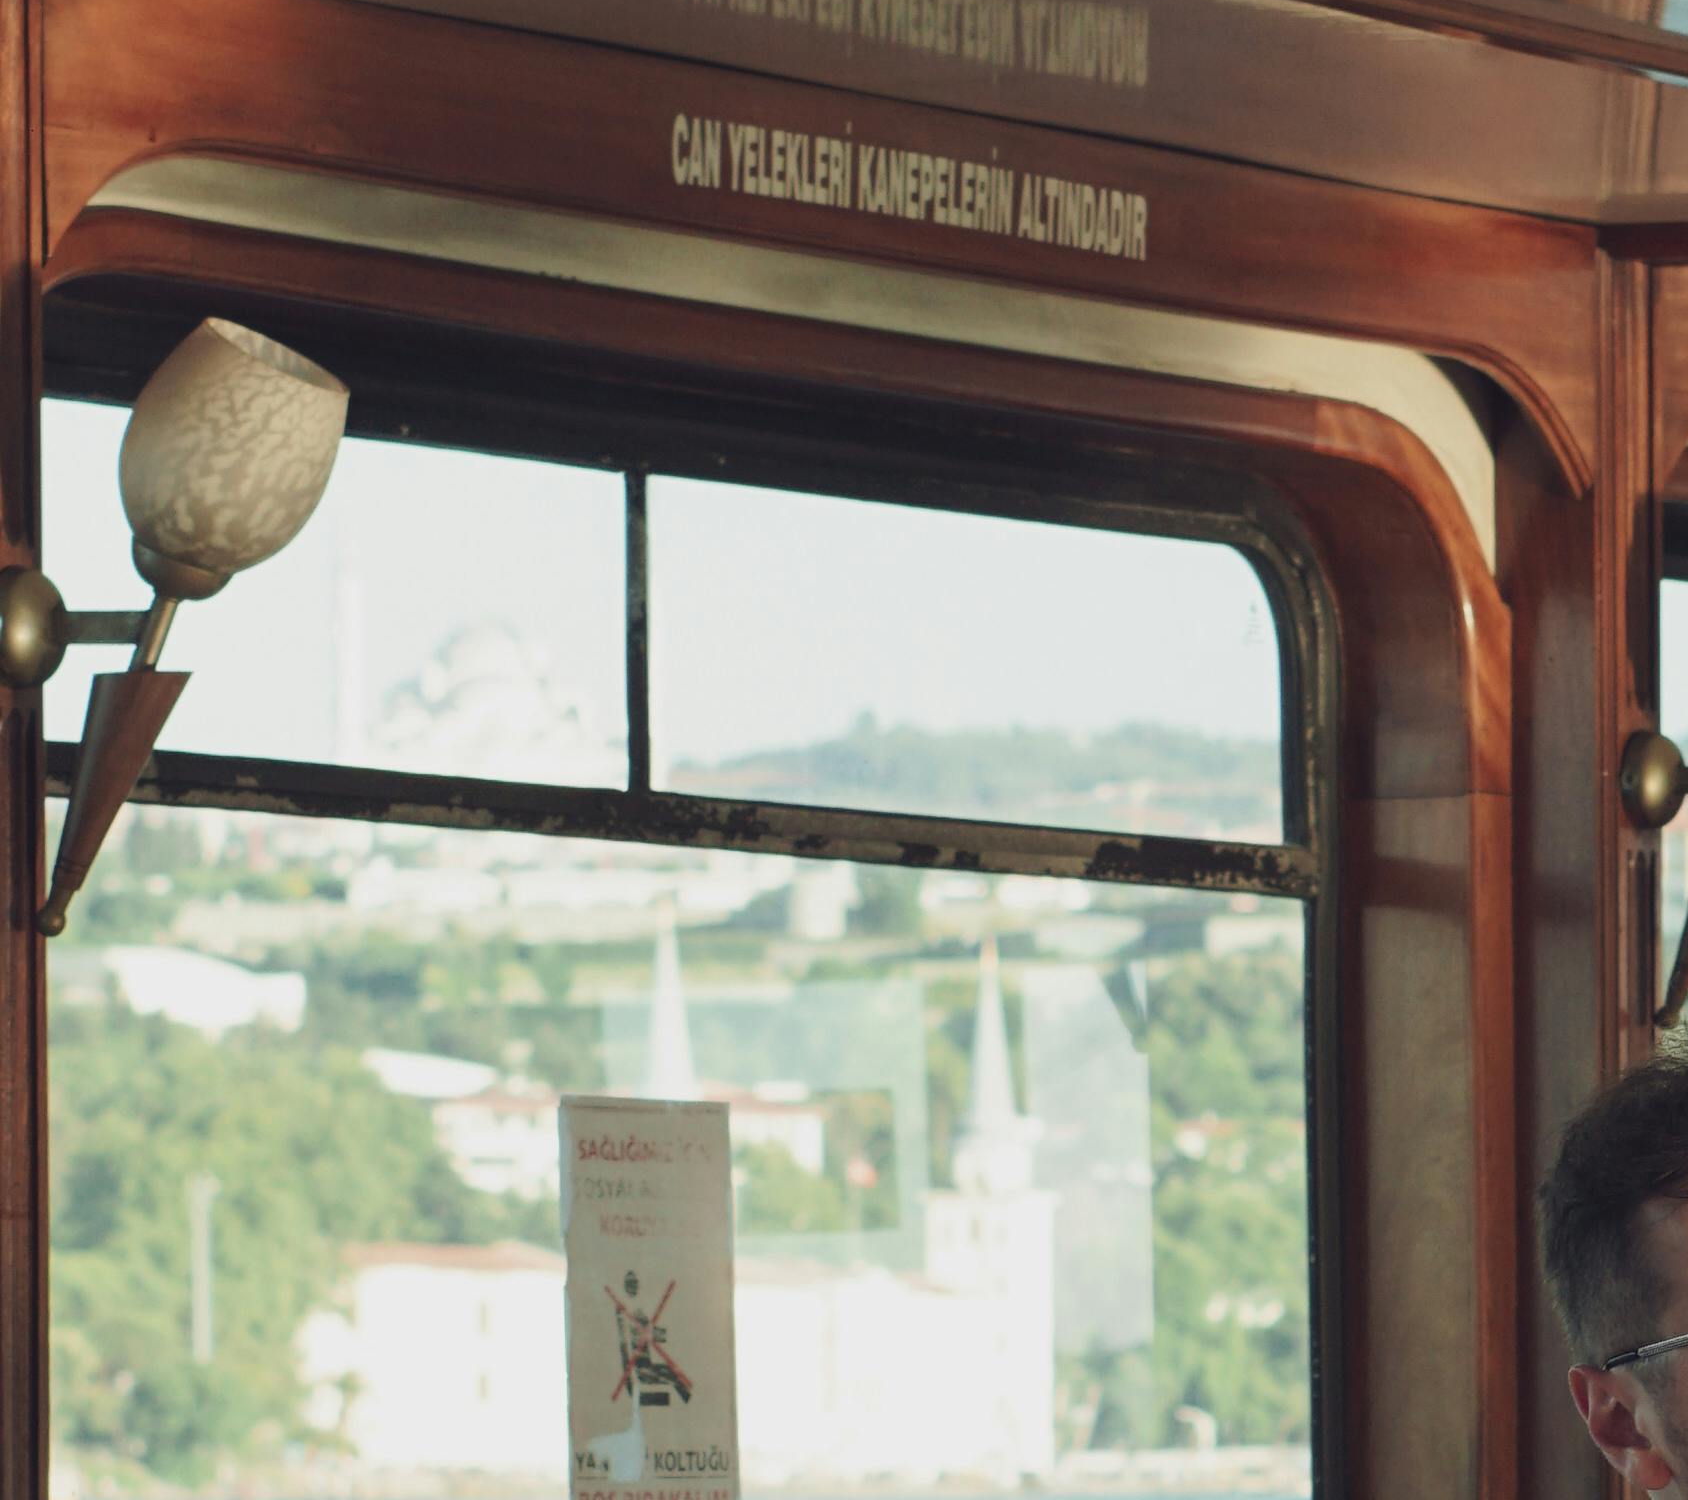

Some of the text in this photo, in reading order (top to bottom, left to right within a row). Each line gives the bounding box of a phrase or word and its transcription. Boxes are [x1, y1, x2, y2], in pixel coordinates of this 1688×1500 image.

[672, 113, 1147, 261] CAN YELEKLERİ KANEPELERİN ALTINDADIR
[654, 1445, 729, 1472] KOLTUĞU
